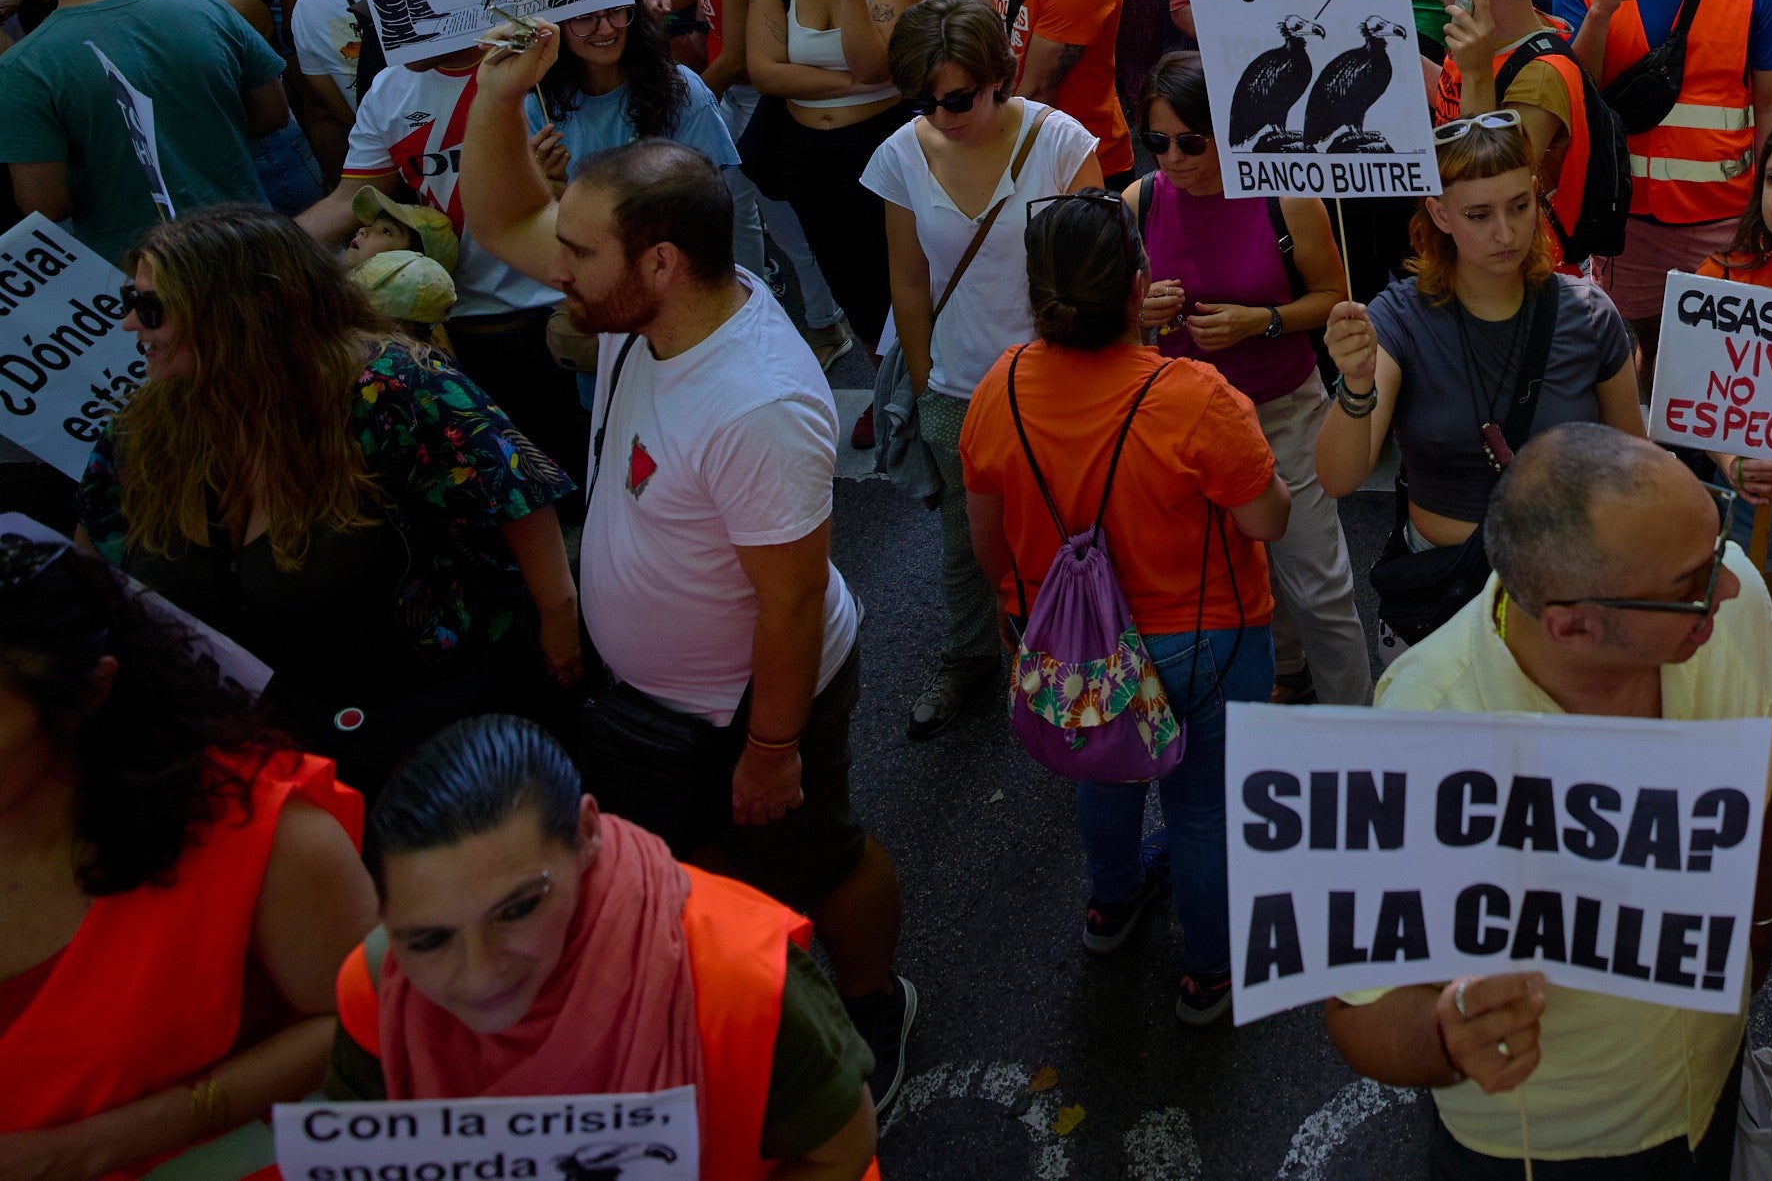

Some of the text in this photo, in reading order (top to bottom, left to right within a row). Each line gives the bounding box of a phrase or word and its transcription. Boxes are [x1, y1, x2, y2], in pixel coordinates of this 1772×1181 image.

[1237, 160, 1432, 195] BANCO BUITRE.
[1706, 370, 1756, 407] NO
[1241, 768, 1752, 874] SIN CASA?
[1242, 881, 1737, 993] A LA CALLE!
[302, 1102, 671, 1143] Con la crisis,
